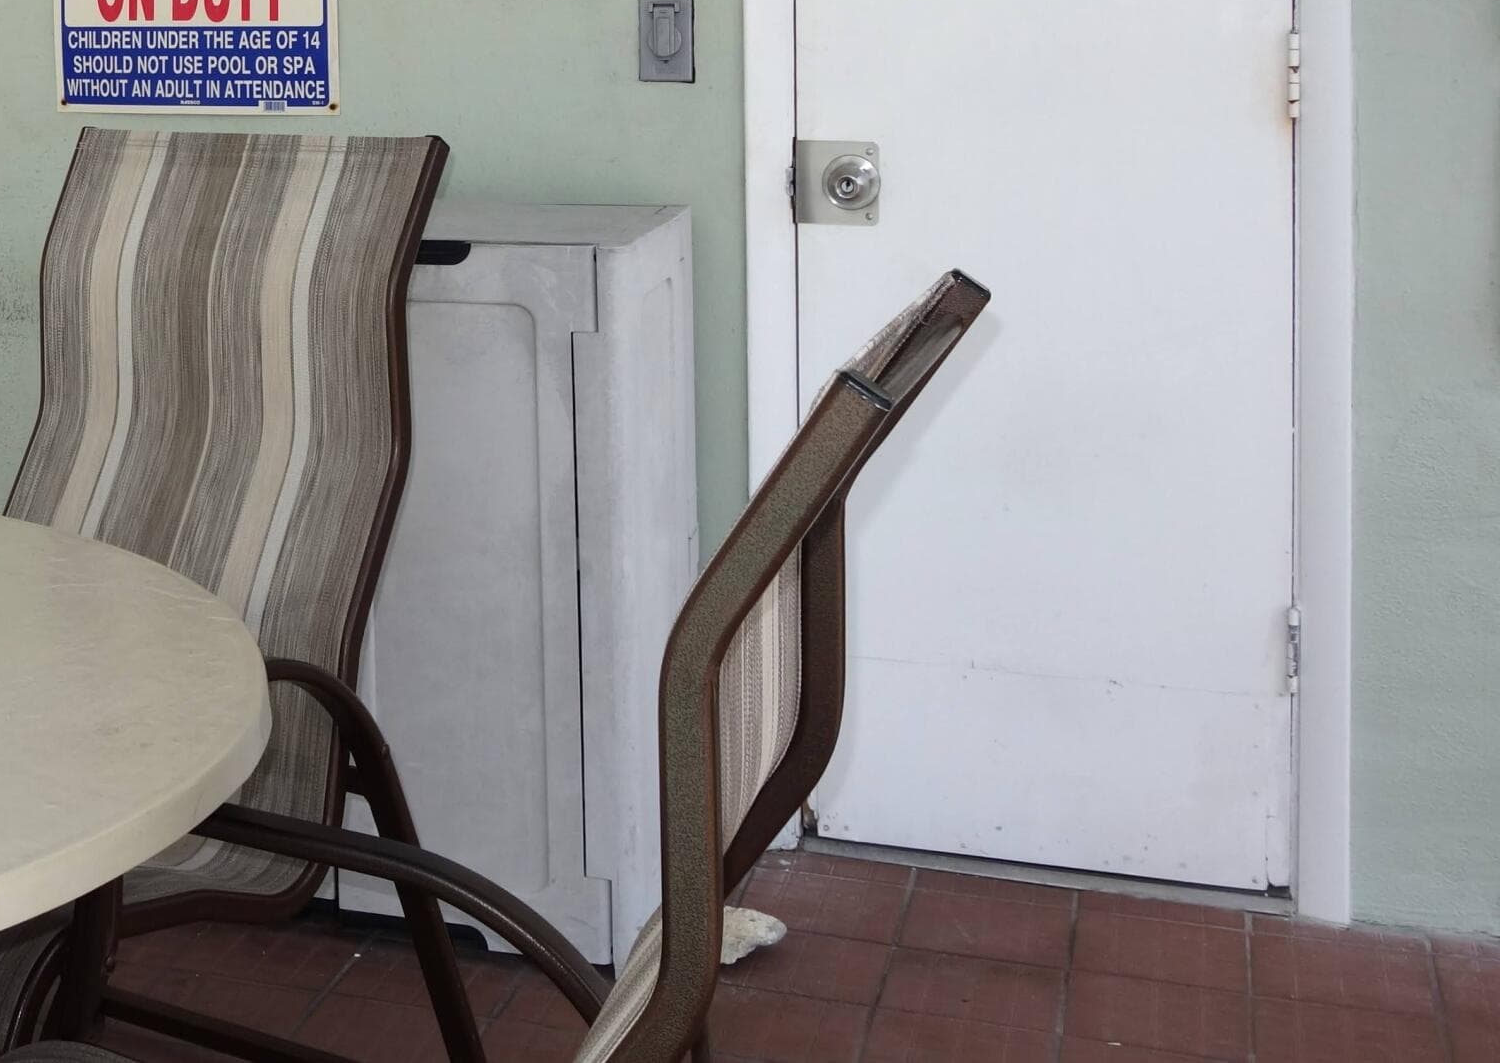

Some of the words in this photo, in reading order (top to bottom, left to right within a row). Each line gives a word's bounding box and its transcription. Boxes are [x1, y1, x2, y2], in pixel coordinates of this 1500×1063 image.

[68, 30, 142, 49] CHILDREN
[146, 31, 199, 50] UNDER
[203, 31, 235, 50] THE
[238, 31, 271, 50] AGE
[276, 31, 298, 50] OF
[303, 31, 320, 50] 14
[73, 55, 133, 74] SHOULD
[137, 55, 168, 74] NOT
[172, 55, 203, 74] USE
[208, 56, 250, 75] POOL
[255, 56, 278, 75] OR
[283, 56, 316, 75] SPA
[67, 78, 128, 97] WITHOUT
[131, 79, 151, 98] AN
[155, 79, 201, 98] ADULT
[206, 80, 221, 99] IN
[224, 80, 326, 99] ATTENDANCE
